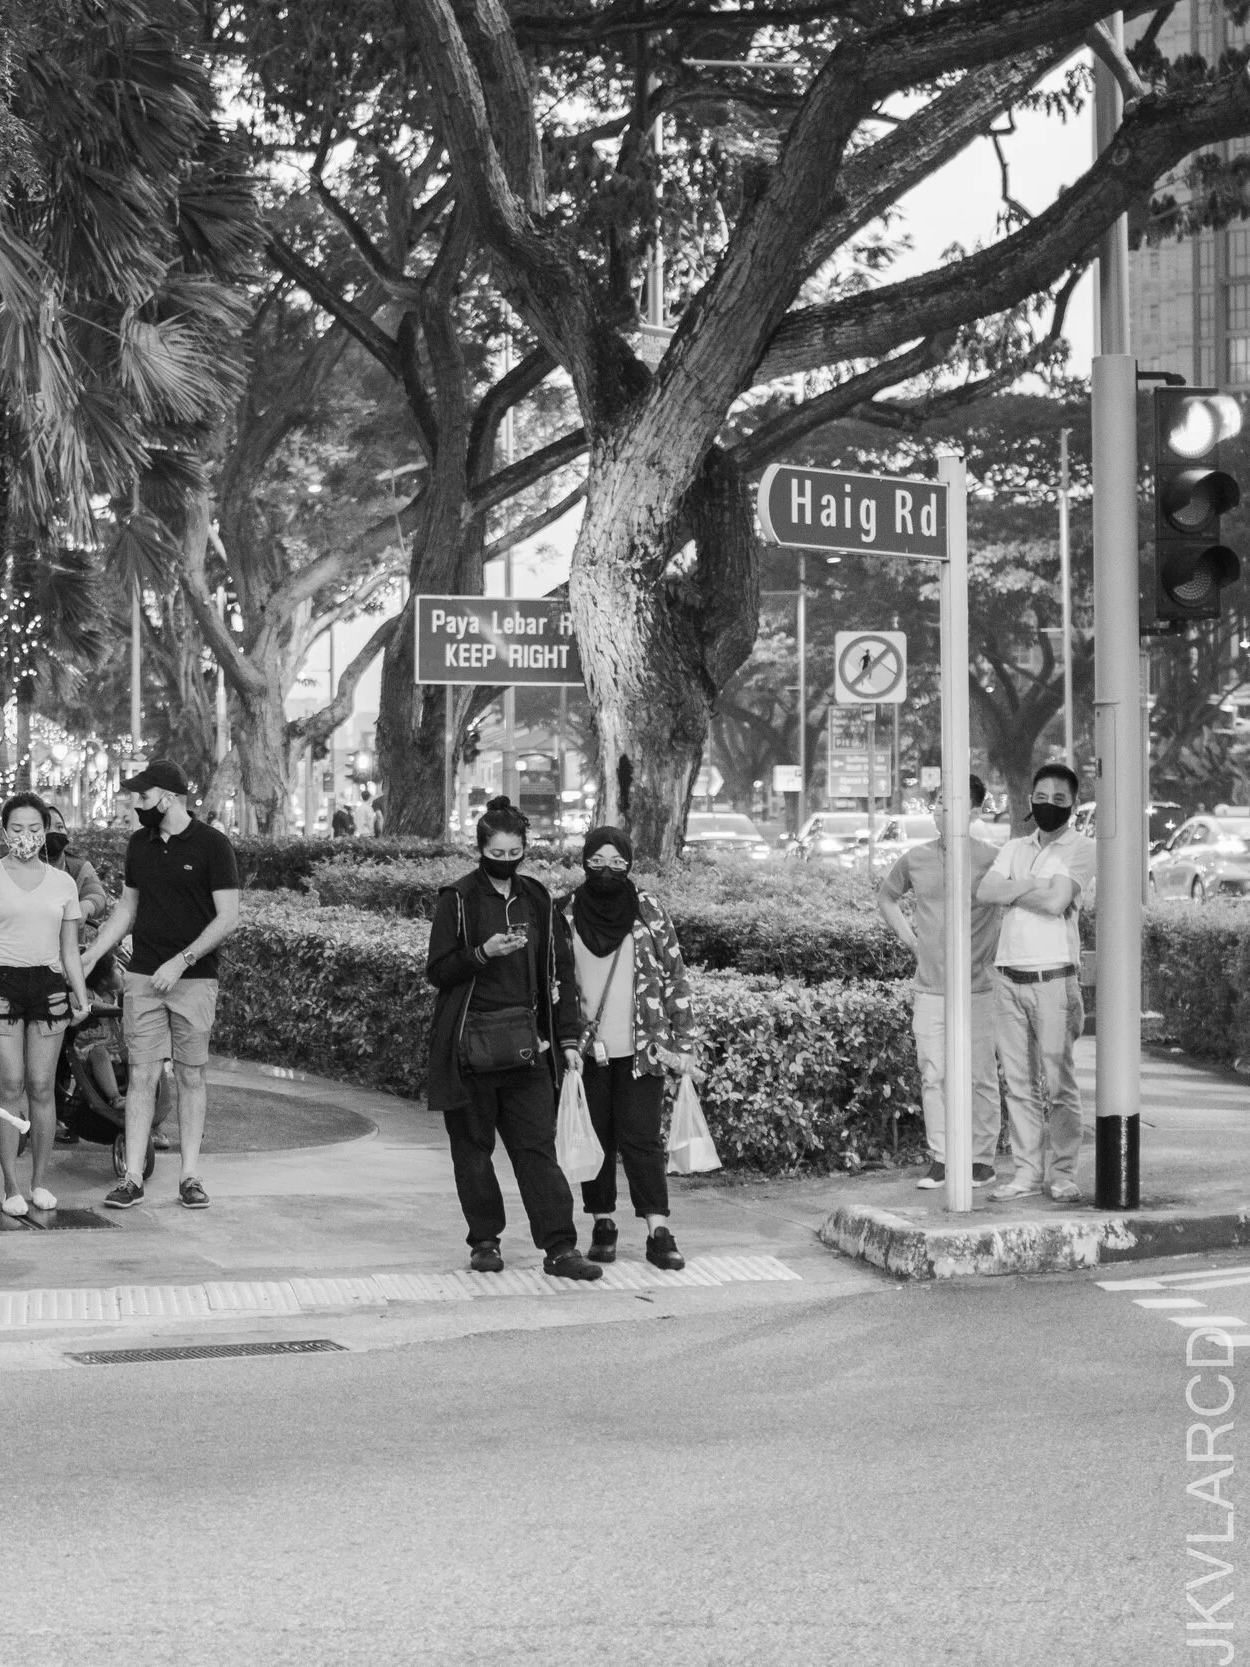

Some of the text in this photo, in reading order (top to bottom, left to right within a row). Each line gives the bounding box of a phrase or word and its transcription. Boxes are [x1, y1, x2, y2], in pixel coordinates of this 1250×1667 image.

[791, 478, 937, 543] Haig Rd
[431, 609, 574, 640] Paya Lebar R
[445, 643, 570, 669] KEEP RIGHT
